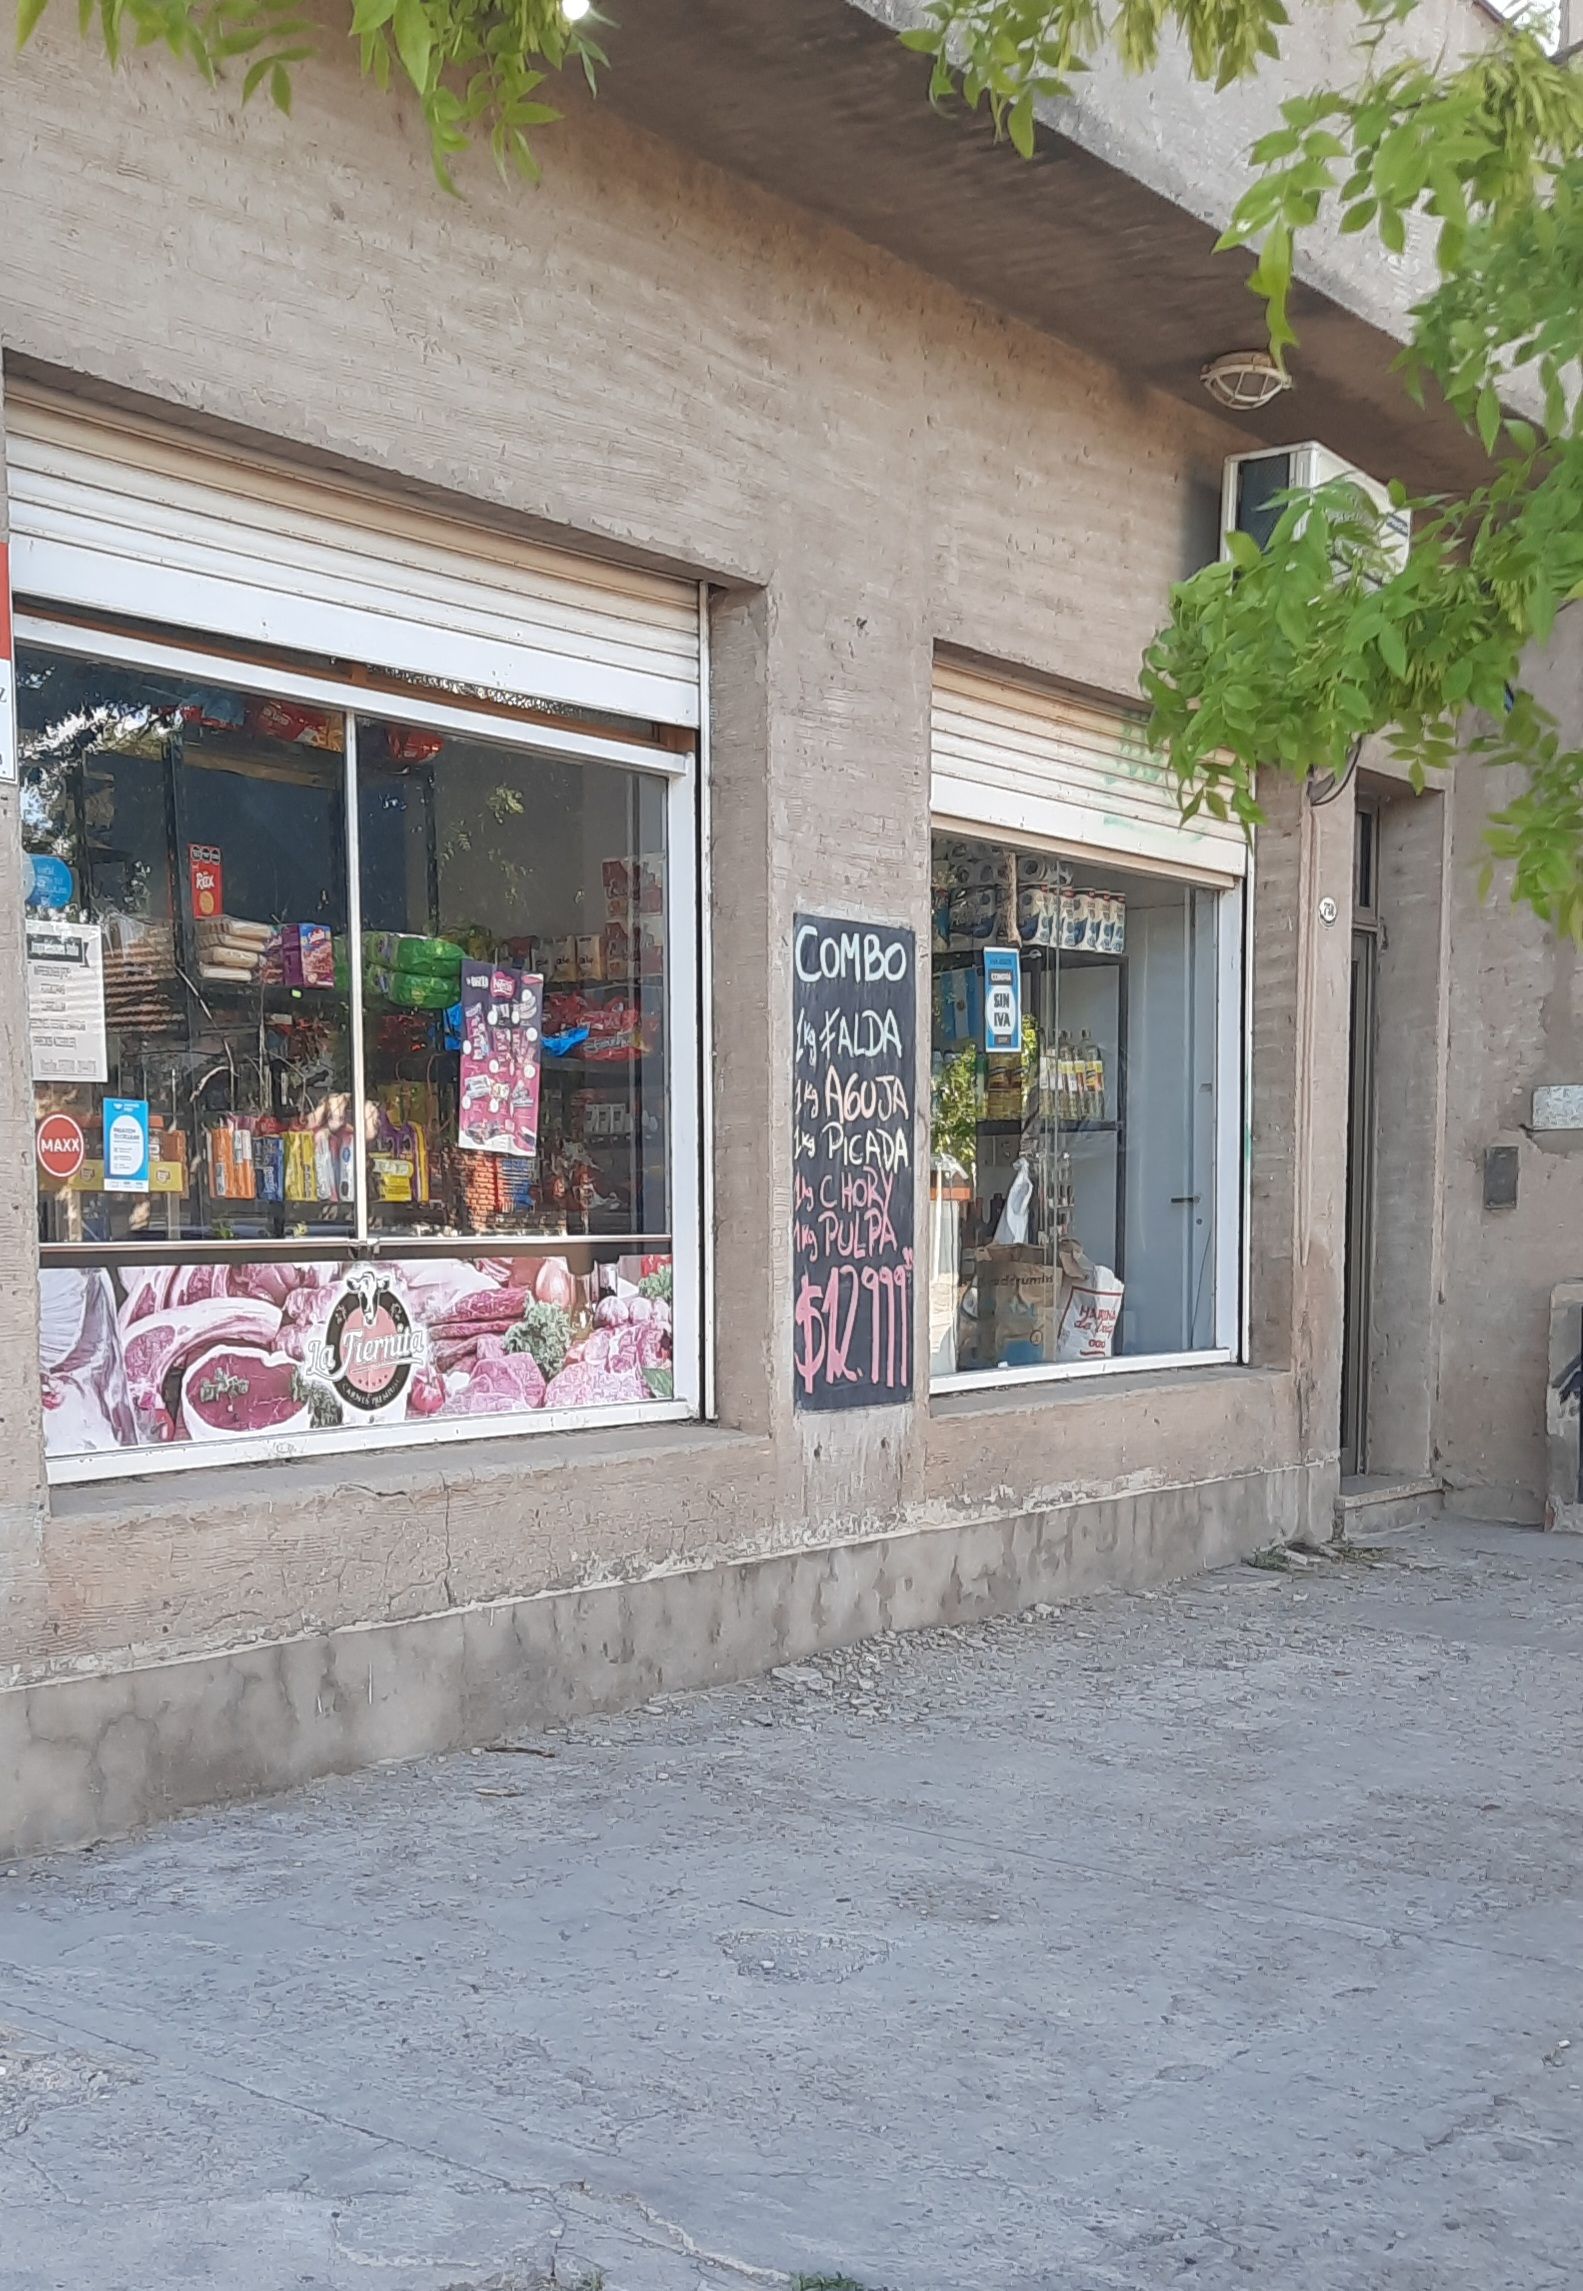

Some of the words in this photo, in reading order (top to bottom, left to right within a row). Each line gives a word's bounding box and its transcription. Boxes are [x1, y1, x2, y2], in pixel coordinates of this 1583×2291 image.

[795, 925, 907, 983] COMBO
[994, 993, 1010, 1008] SIN
[994, 1012, 1011, 1027] IVA
[819, 1007, 902, 1060] FALDA
[825, 1064, 909, 1124] AGUJA
[41, 1137, 80, 1153] MAXX
[822, 1122, 909, 1174] PICADA
[818, 1207, 898, 1259] PULPA
[305, 1340, 337, 1376] La
